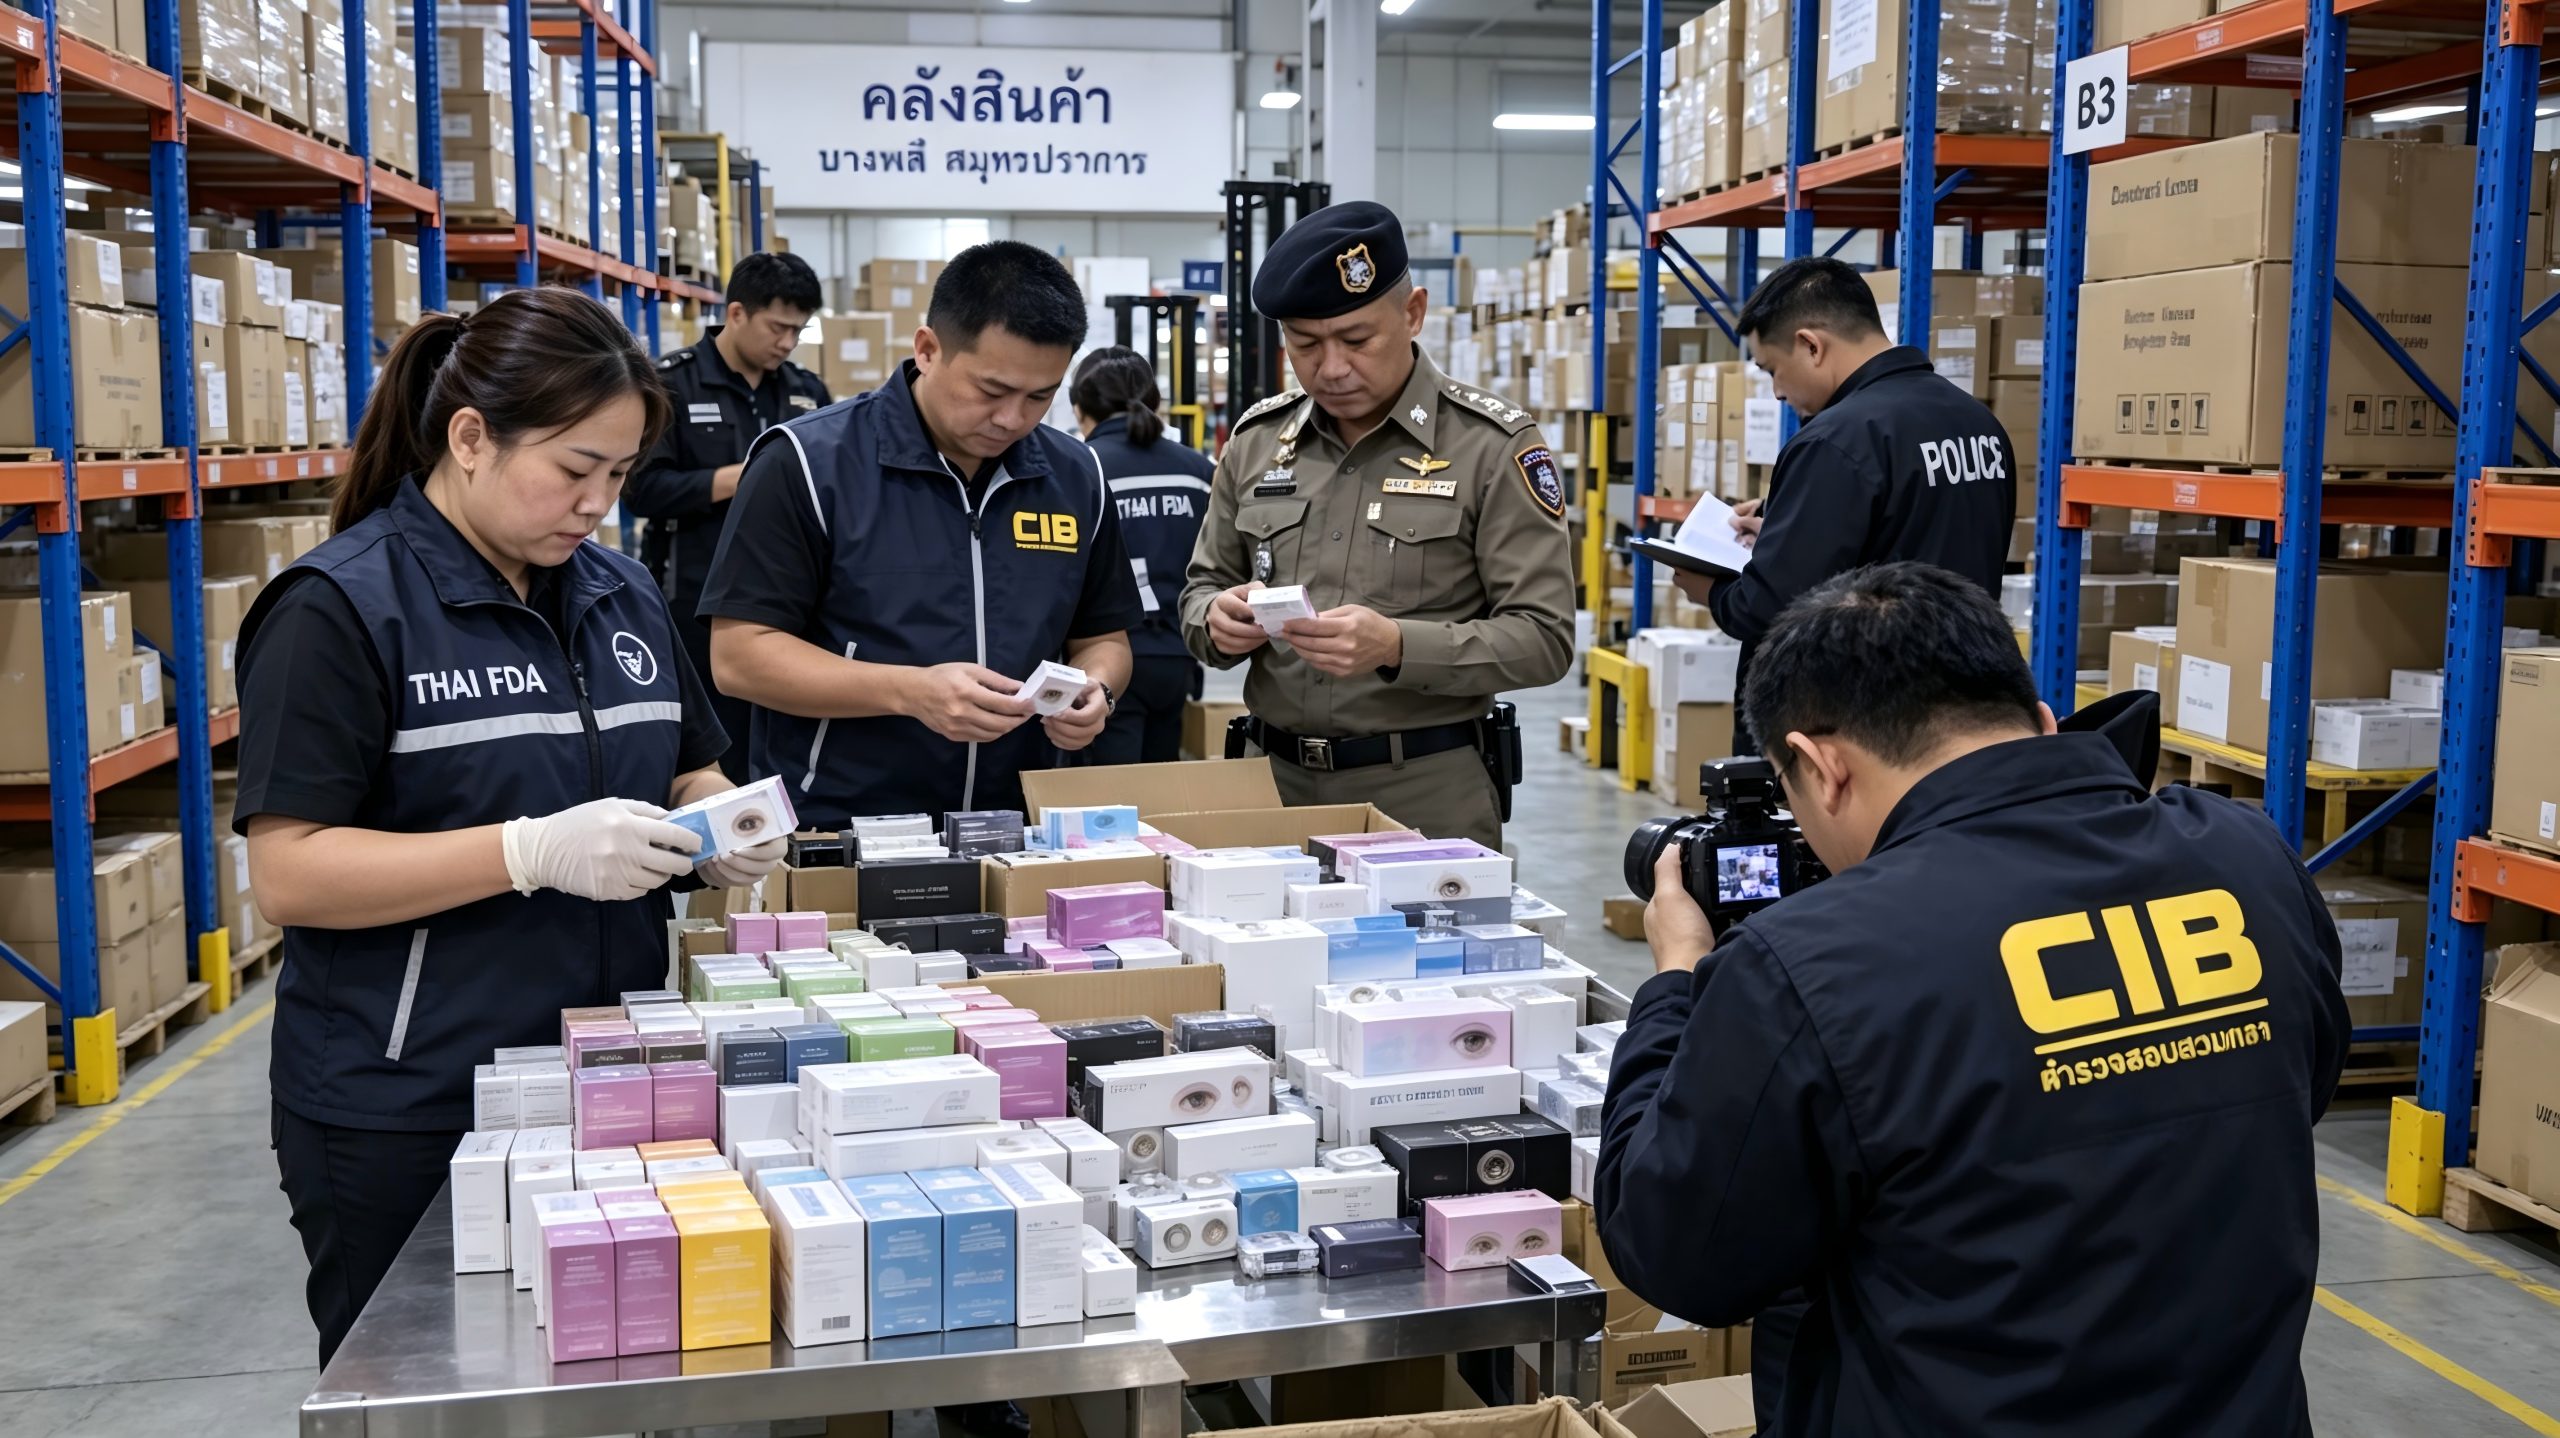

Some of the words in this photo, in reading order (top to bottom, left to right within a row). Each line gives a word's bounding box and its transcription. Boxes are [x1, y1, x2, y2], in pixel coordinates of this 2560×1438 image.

[863, 65, 1112, 123] คลังสินค้า
[2077, 76, 2116, 130] B3
[1012, 511, 1079, 545] CIB
[408, 669, 482, 705] THAI
[486, 663, 549, 696] FDA
[1999, 888, 2263, 1035] CIB
